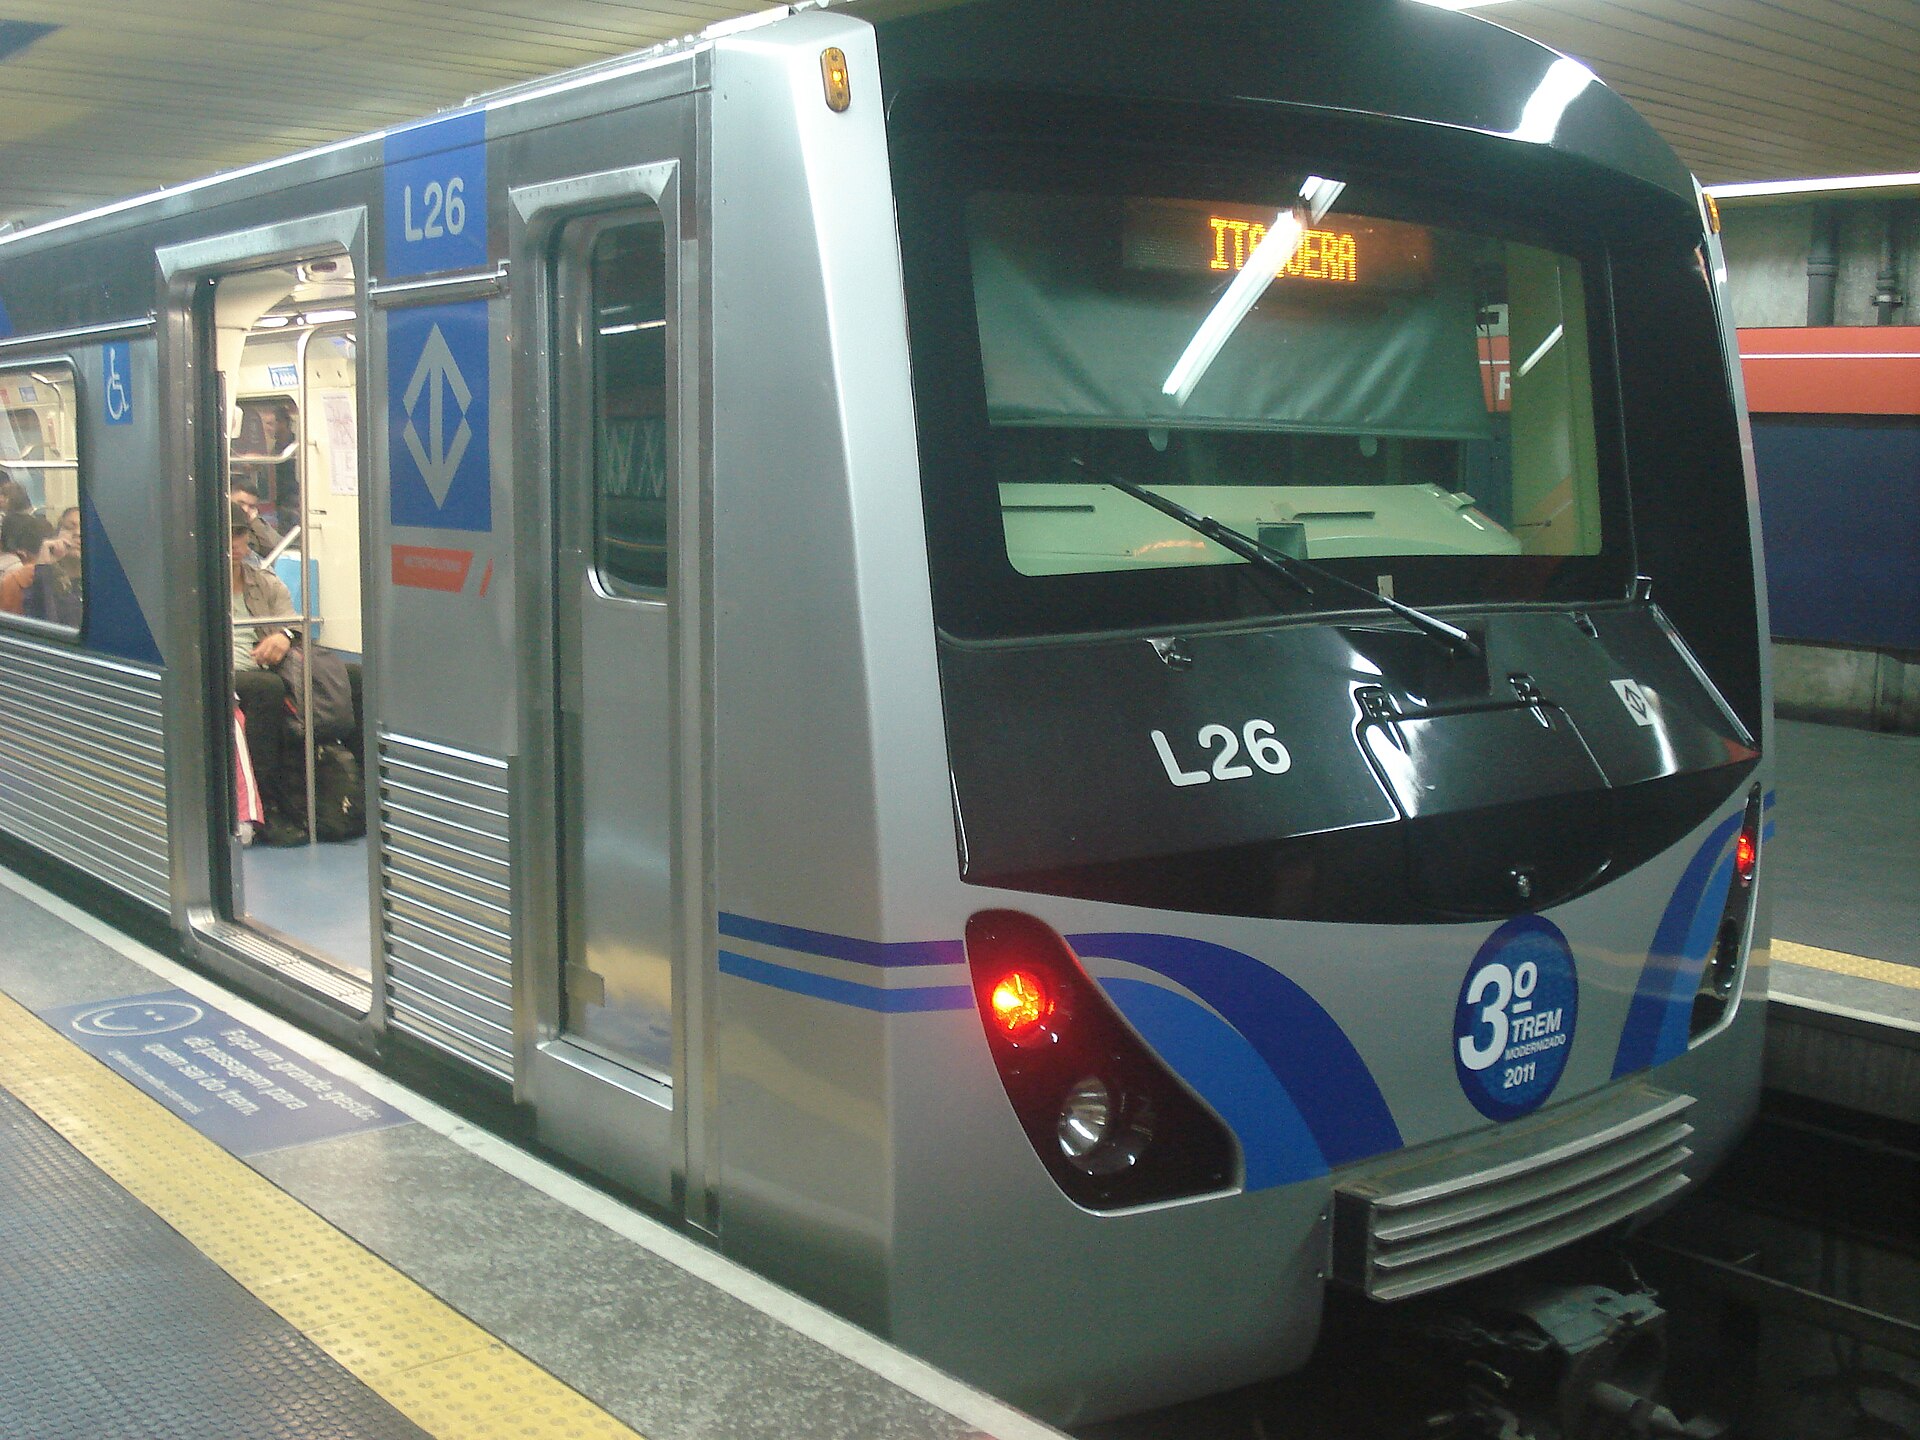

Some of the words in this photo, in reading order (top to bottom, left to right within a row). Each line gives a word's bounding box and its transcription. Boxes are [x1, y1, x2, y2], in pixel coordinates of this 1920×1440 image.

[404, 176, 465, 241] L26
[1150, 718, 1292, 787] L26
[1503, 1033, 1567, 1060] MODERNIZADO
[1511, 1007, 1563, 1043] TREM
[192, 1046, 274, 1090] passagem
[257, 1086, 308, 1111] para
[251, 1049, 284, 1064] um
[268, 1061, 333, 1092] grande
[1503, 1061, 1536, 1089] 2011
